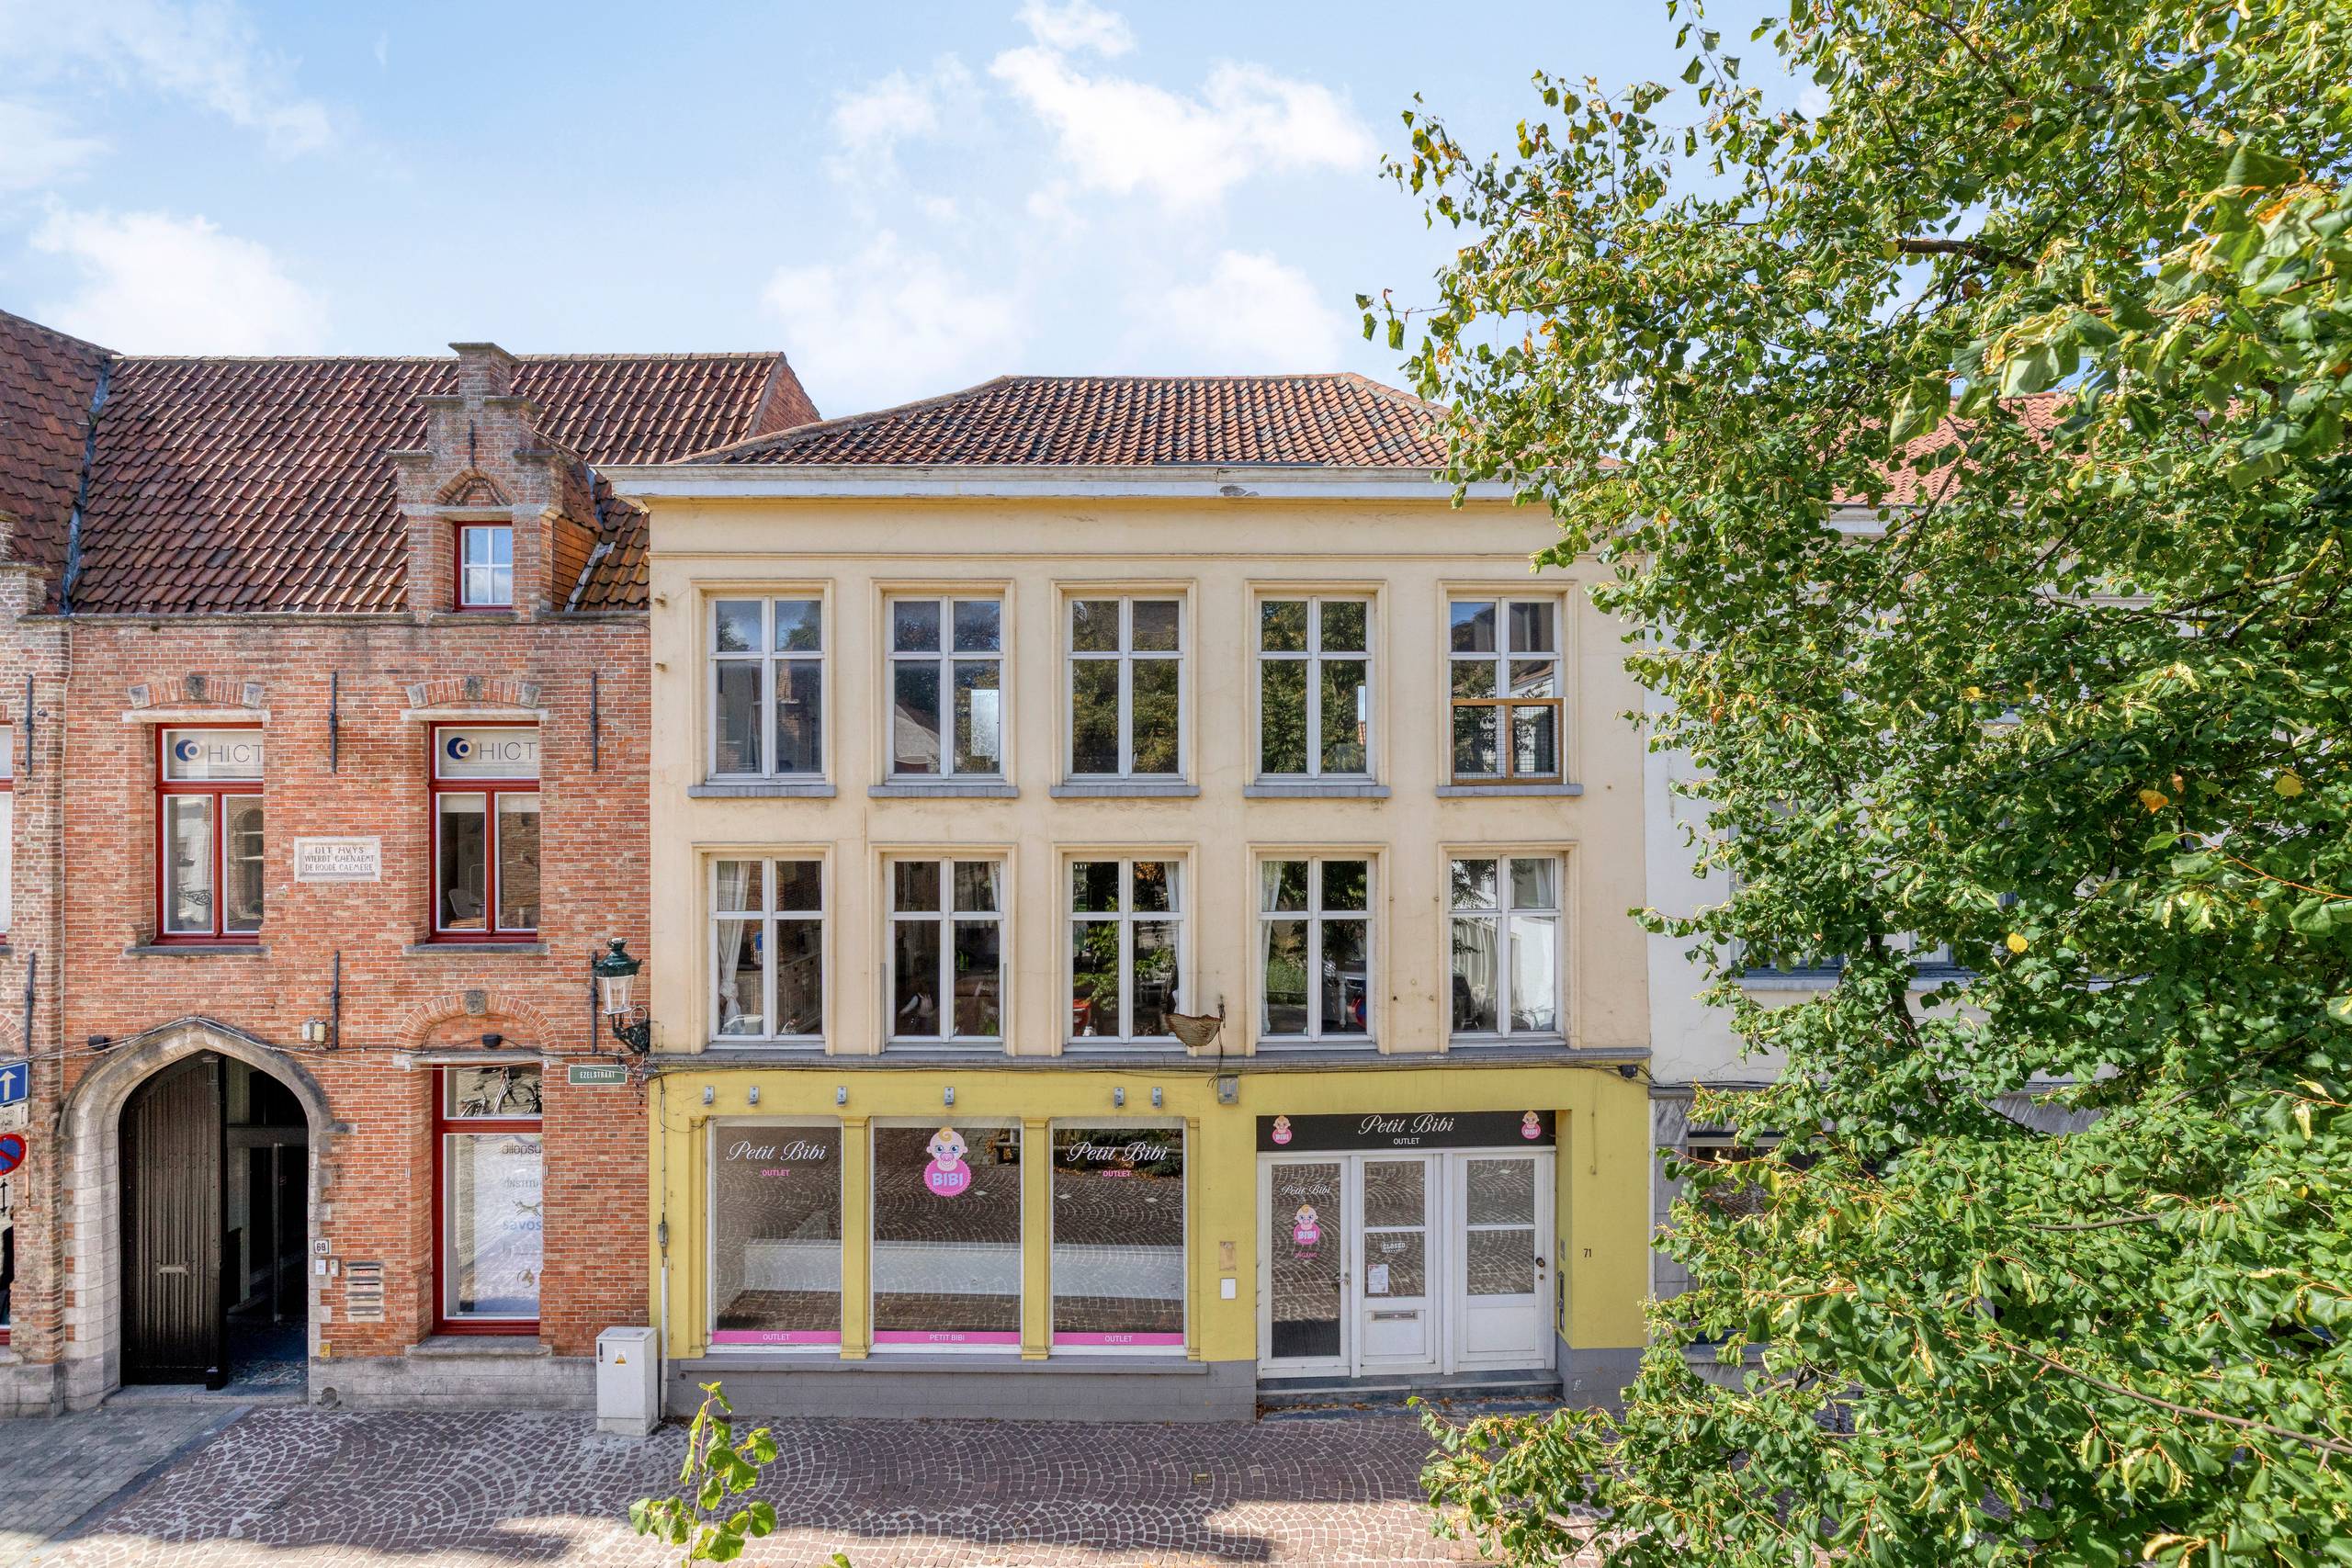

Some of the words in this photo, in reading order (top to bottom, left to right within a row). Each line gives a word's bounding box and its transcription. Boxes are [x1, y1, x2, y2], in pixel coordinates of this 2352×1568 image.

[209, 745, 264, 762] HICT
[480, 742, 537, 761] HICT
[305, 863, 314, 872] DE
[580, 1071, 615, 1079] EZELSTRAAT
[1358, 1114, 1407, 1134] Petit
[1410, 1113, 1454, 1134] Bibi
[726, 1140, 776, 1161] Petit
[780, 1140, 827, 1161] Bibi
[1067, 1141, 1116, 1162] Petit
[1121, 1141, 1168, 1162] Bibi
[933, 1172, 964, 1186] BIBI
[1280, 1184, 1306, 1195] Petit
[1307, 1183, 1331, 1195] Bibi
[1297, 1230, 1317, 1240] BIBI
[316, 1243, 326, 1251] 69
[1583, 1248, 1592, 1258] 71
[763, 1333, 790, 1341] OUTLET
[1104, 1335, 1133, 1343] OUTLET
